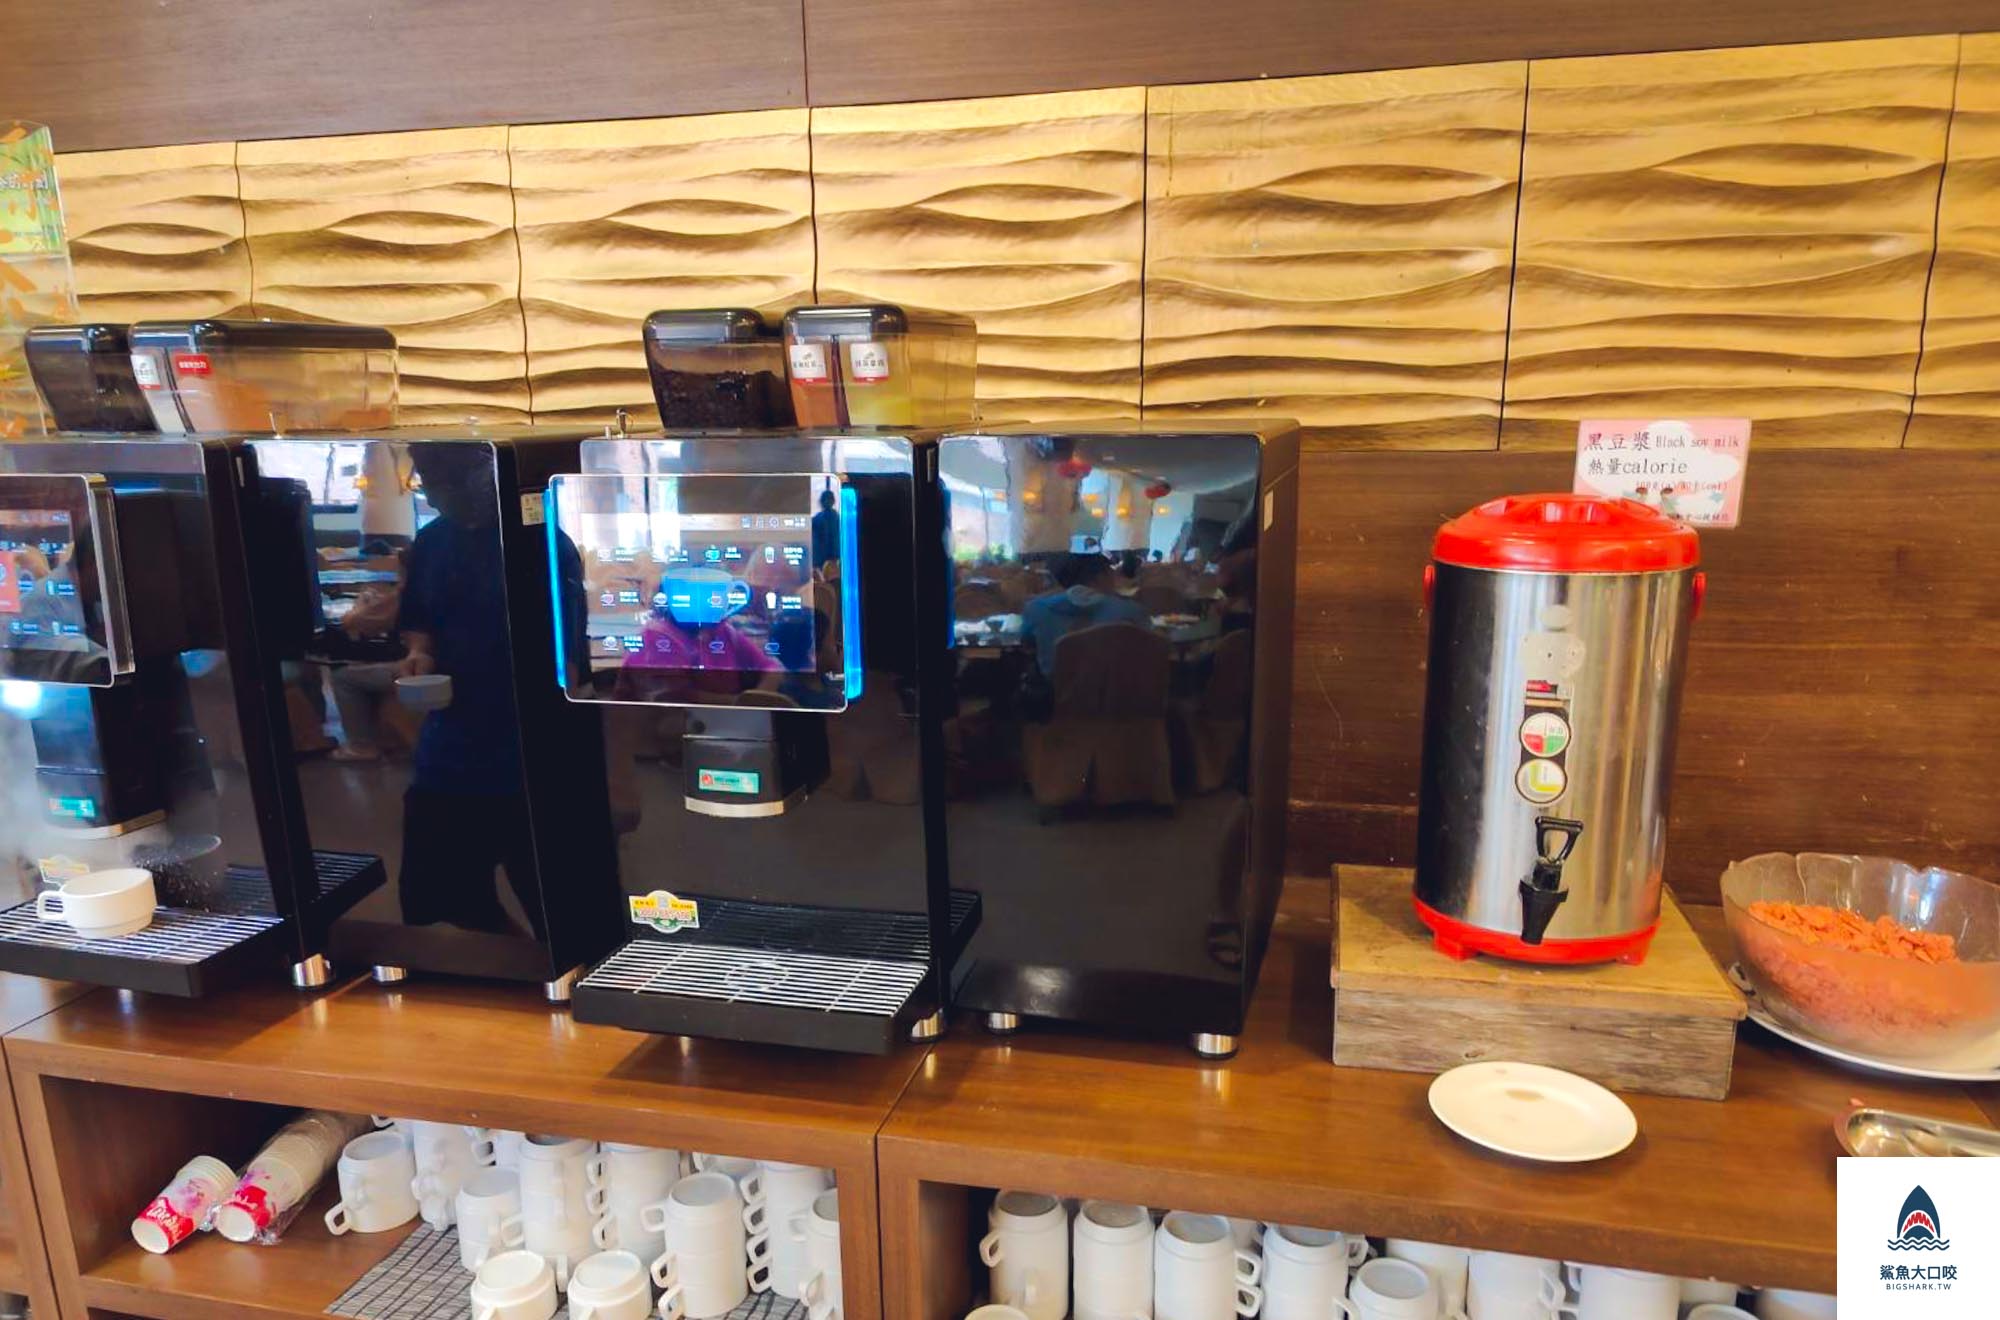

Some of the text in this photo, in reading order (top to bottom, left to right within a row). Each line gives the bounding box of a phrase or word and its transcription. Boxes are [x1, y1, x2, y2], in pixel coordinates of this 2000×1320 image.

[1584, 431, 1651, 451] 黑豆漿
[1656, 434, 1686, 448] Black
[1714, 435, 1739, 448] milk
